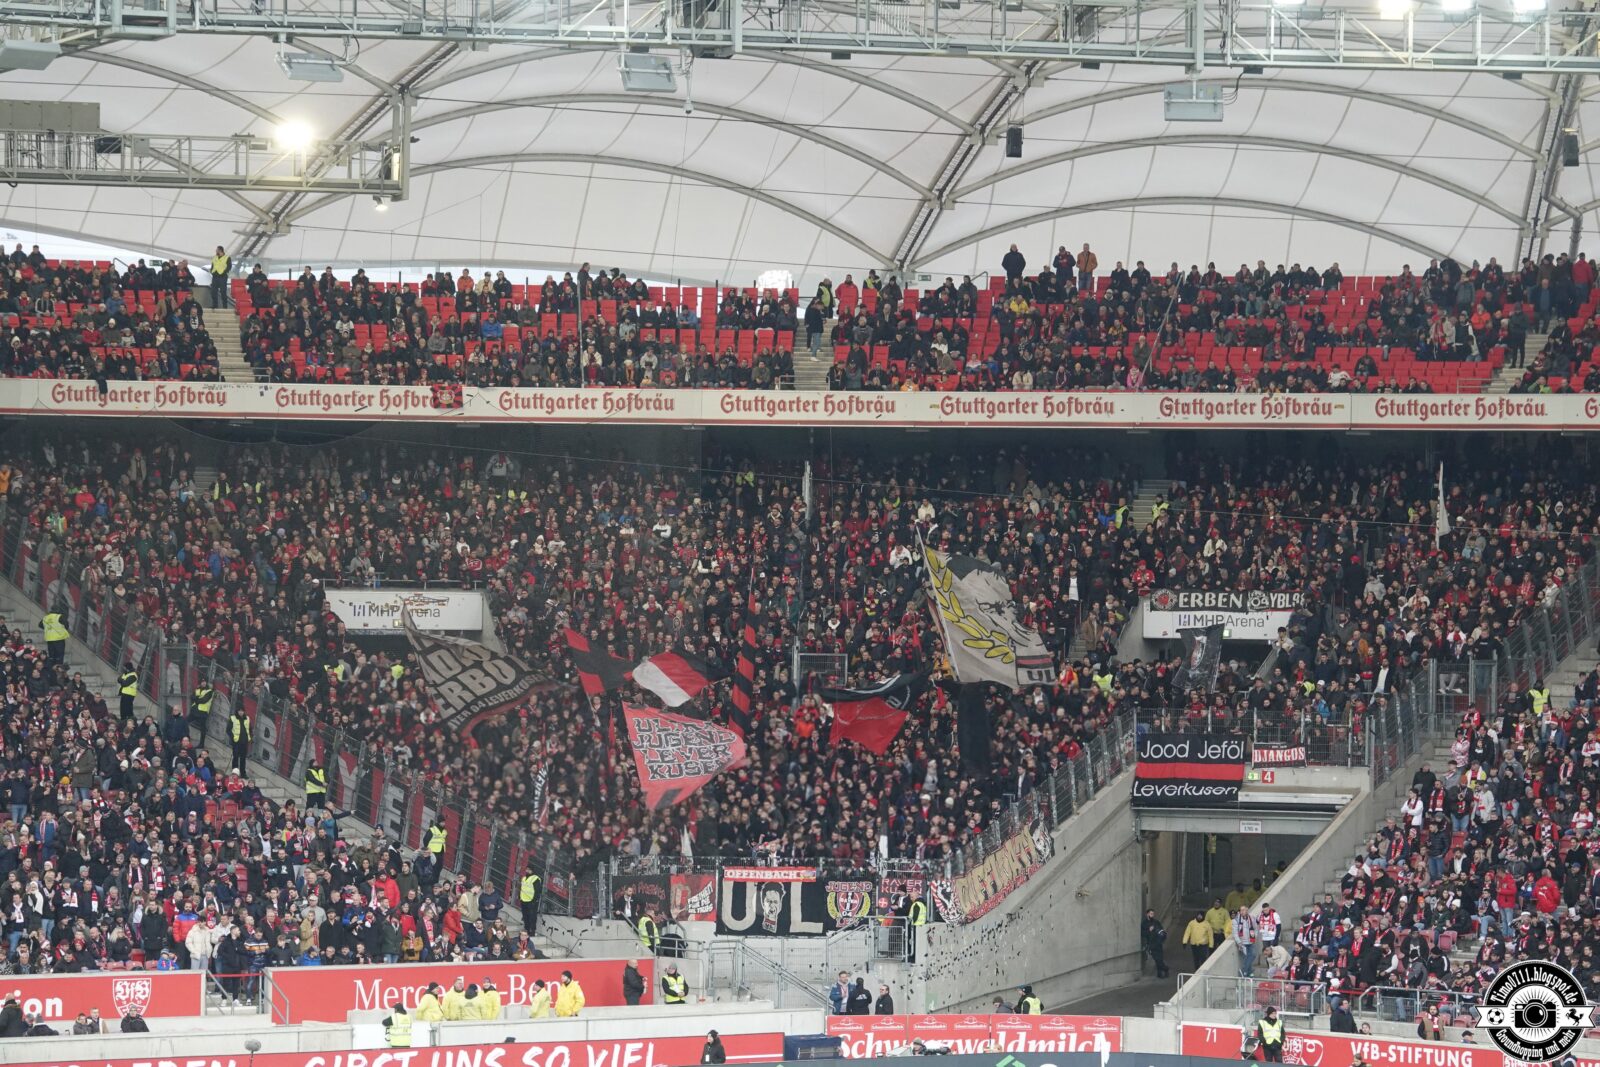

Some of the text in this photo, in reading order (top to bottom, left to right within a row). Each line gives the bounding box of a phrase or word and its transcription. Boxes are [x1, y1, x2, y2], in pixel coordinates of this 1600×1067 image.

[275, 387, 375, 411] Stuttgarter
[499, 391, 675, 415] Stuttgarter Hofbräu
[720, 393, 896, 417] Stuttgarter Hofbräu
[940, 395, 1115, 419] Stuttgarter Hofbräu
[1159, 396, 1333, 420] Stuttgarter Hofbräu
[1375, 397, 1546, 421] Stuttgarter Hofbräu
[1178, 591, 1243, 609] ERBEN
[1141, 740, 1245, 760] Jood Jeföl
[1253, 746, 1306, 763] DJANGOS
[1263, 771, 1273, 783] 4
[1133, 782, 1238, 797] Leverkusen
[727, 869, 798, 879] OFFENBACH
[881, 886, 922, 894] KUEN
[1205, 1027, 1218, 1044] 71
[1350, 1041, 1473, 1067] VfB-STIFTUNG
